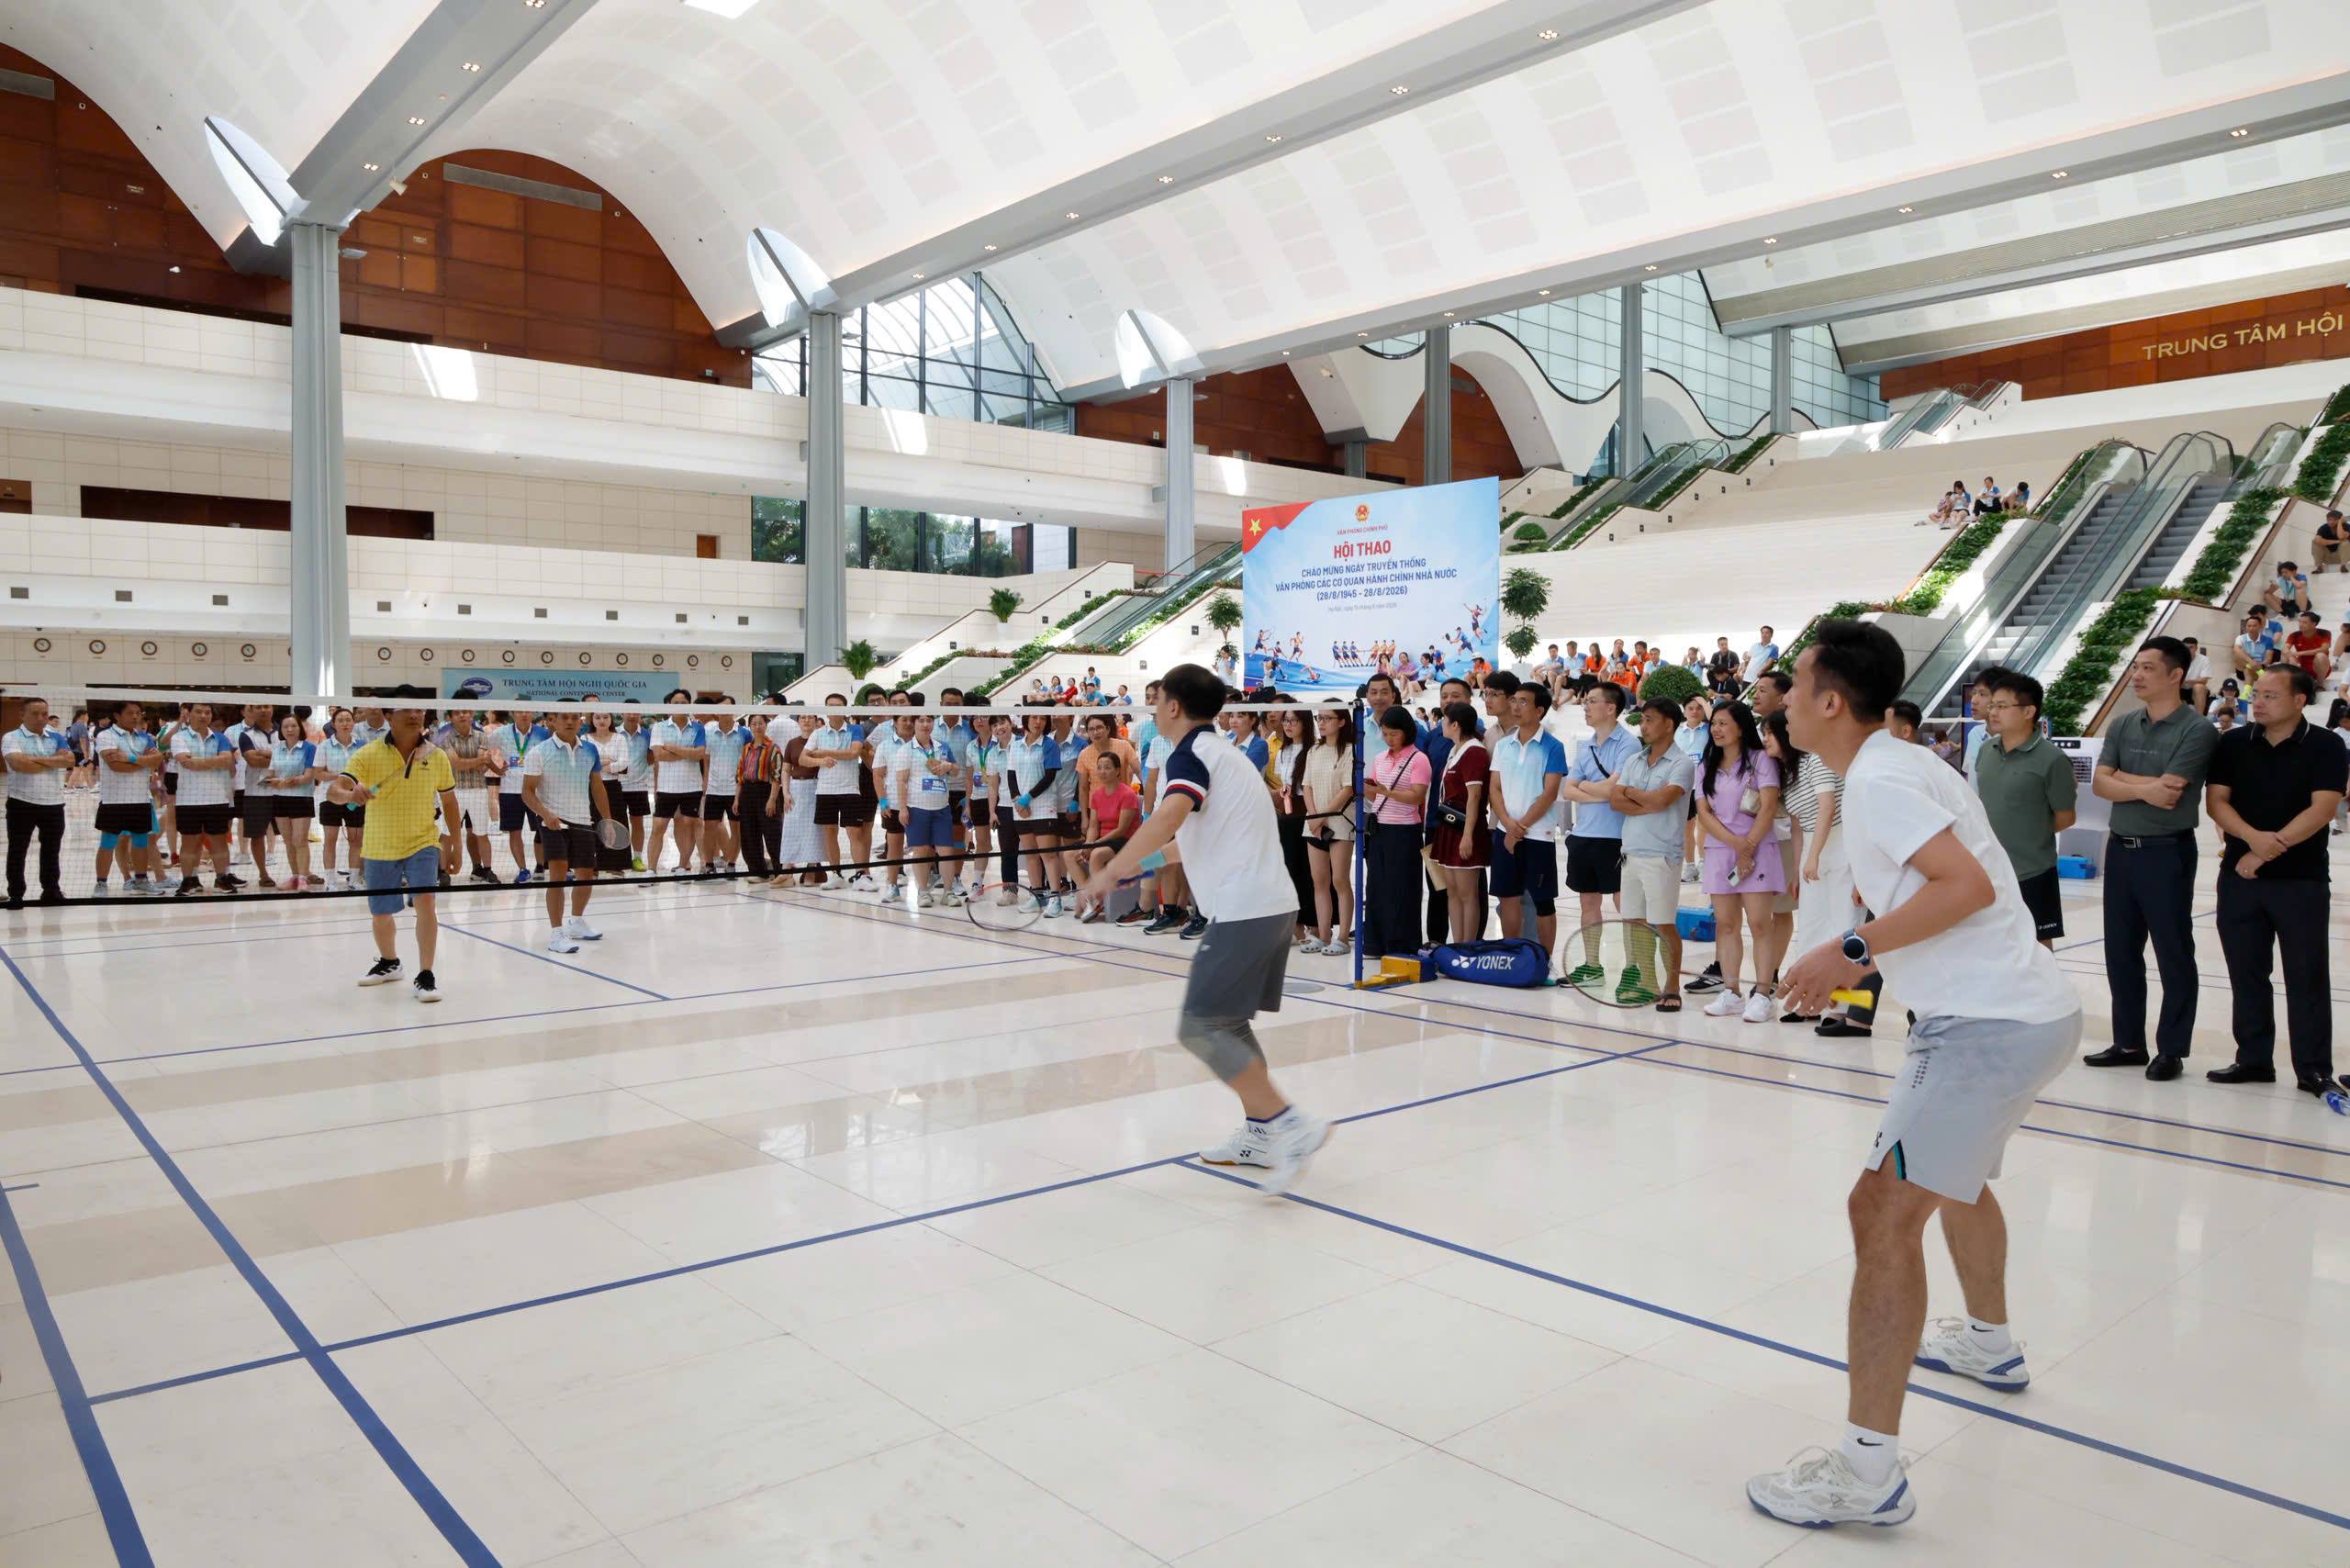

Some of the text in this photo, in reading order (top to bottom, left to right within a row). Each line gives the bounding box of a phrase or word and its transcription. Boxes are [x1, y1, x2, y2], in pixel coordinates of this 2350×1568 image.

[2143, 311, 2343, 361] TRUNG TÂM HỘI
[1334, 540, 1392, 562] HỘI THAO
[1343, 577, 1365, 587] QUAN
[536, 678, 555, 688] TÂM
[559, 678, 576, 689] HỘI
[578, 680, 601, 689] NGHỊ
[604, 679, 629, 689] QUỐC
[1476, 956, 1516, 970] YONEX
